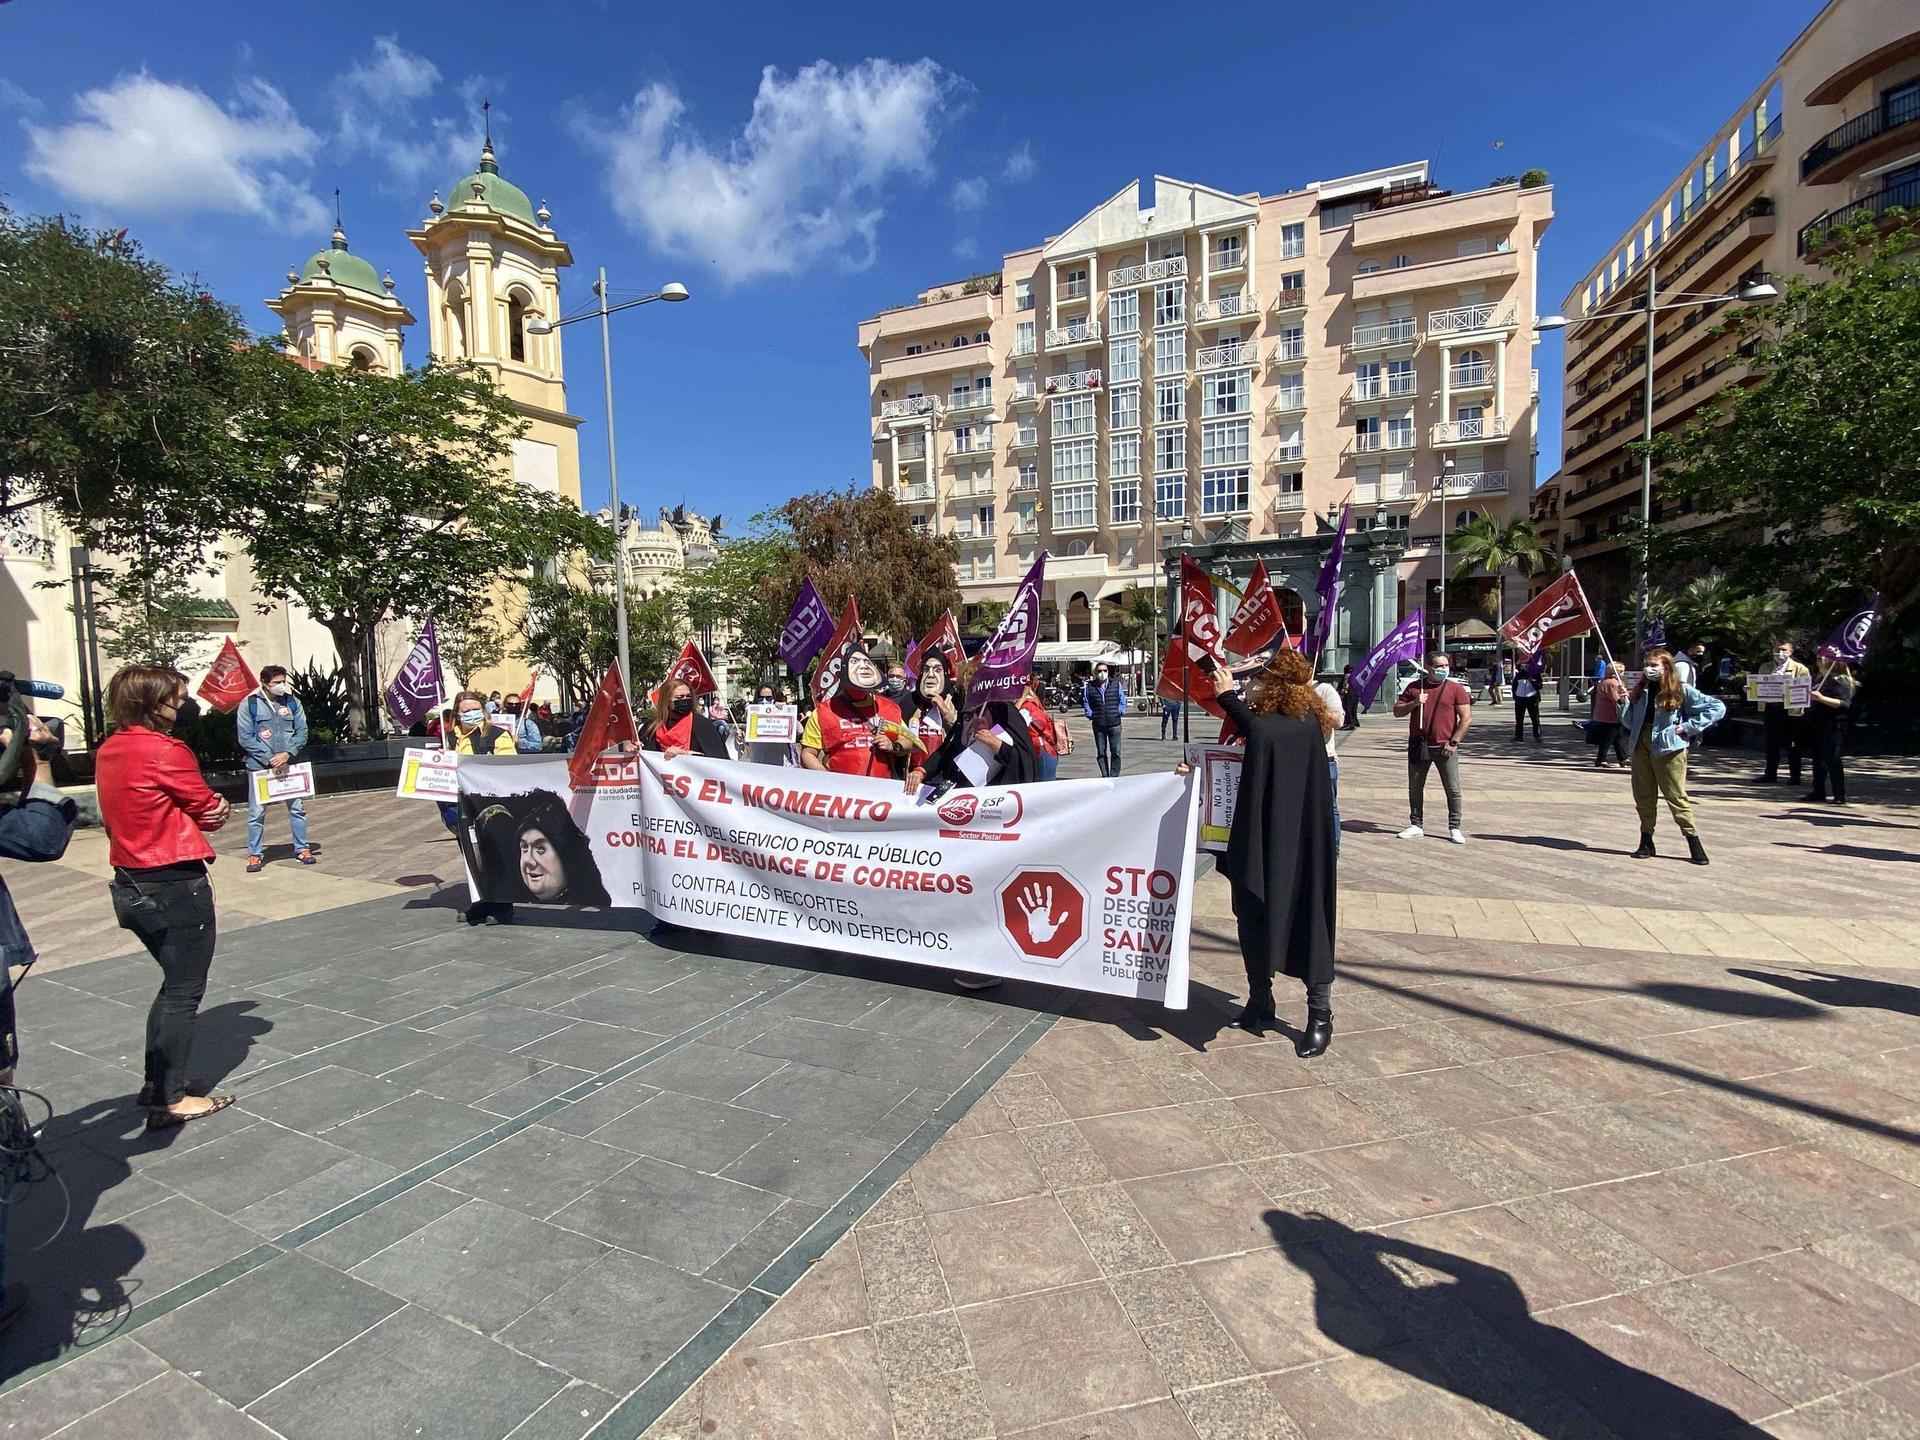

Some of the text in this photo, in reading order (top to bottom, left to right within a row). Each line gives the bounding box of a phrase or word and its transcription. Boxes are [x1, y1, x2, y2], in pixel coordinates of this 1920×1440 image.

[661, 773, 893, 822] ES EL MOMENTO
[1214, 795, 1221, 807] NO
[645, 816, 703, 836] DEFENSA
[705, 825, 727, 841] DEL
[729, 829, 799, 851] SERVICIO
[802, 839, 863, 860] POSTAL
[867, 843, 942, 867] PÚBLICO
[981, 833, 1001, 841] Postal
[606, 831, 974, 895] CONTRA EL DESGUACE DE CORREOS
[672, 873, 865, 919] CONTRA LOS RECORTES,
[681, 897, 788, 926] INSUFICIENTE
[793, 912, 805, 929] Y
[807, 915, 843, 936] CON
[848, 922, 953, 951] DERECHOS.
[1103, 914, 1122, 926] DE
[1103, 951, 1120, 965] EL
[1102, 966, 1153, 982] PUBLICO
